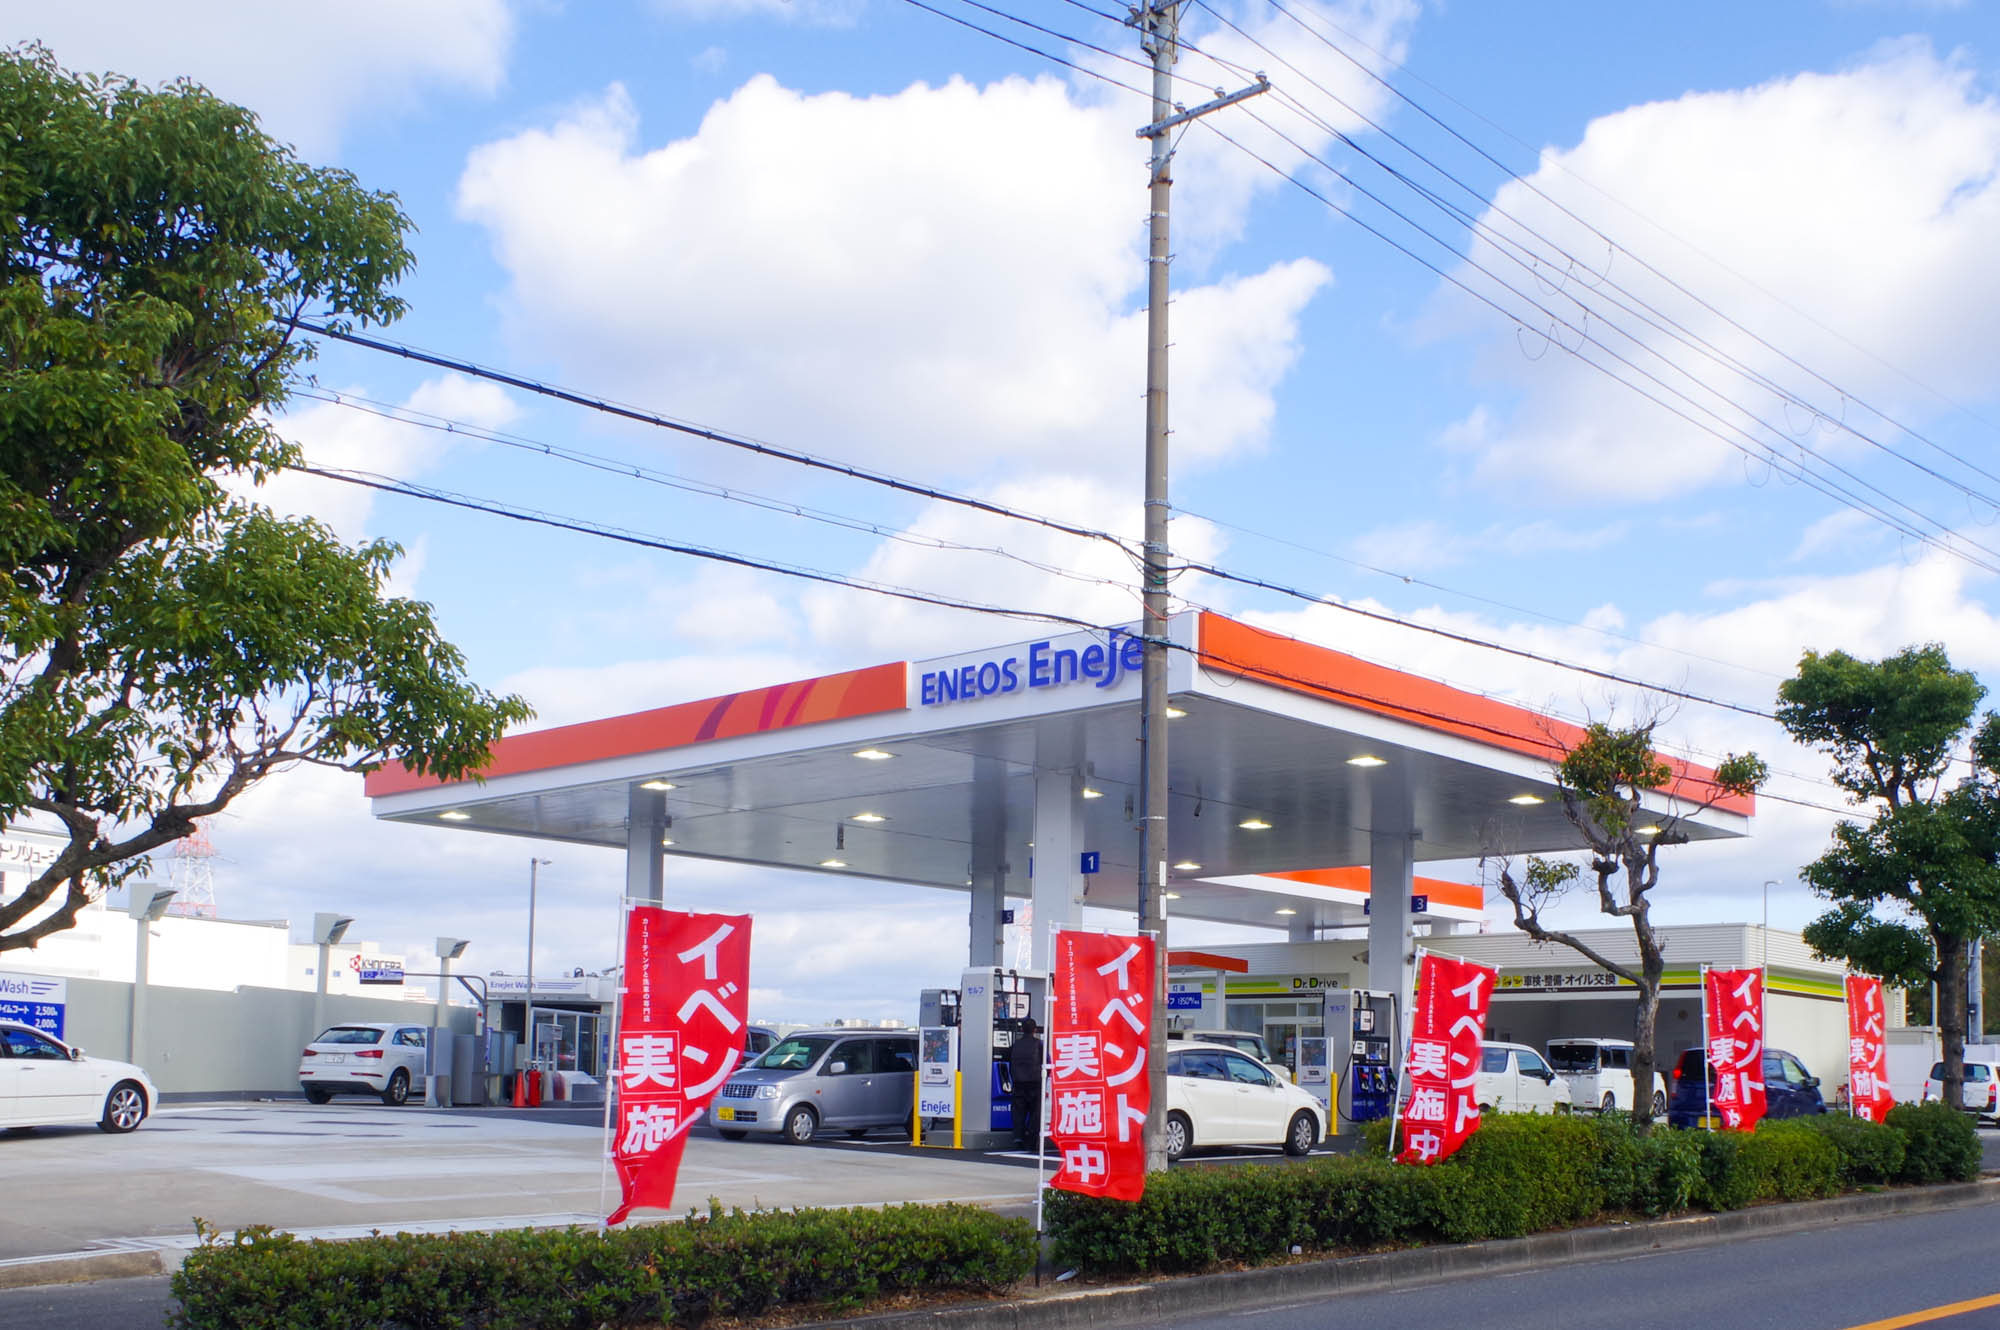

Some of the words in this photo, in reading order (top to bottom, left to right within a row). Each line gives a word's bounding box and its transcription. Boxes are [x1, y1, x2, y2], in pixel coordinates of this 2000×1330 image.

[921, 657, 1018, 705] ENEOS
[1029, 626, 1143, 688] Eneje
[1087, 855, 1095, 870] 1
[1416, 897, 1424, 910] 3
[677, 922, 741, 1101] イベン
[1096, 943, 1147, 1143] イベント
[1449, 972, 1487, 1134] イベント
[1732, 973, 1765, 1105] イベント
[1864, 983, 1890, 1101] イベント
[621, 1034, 676, 1155] 実施
[1054, 1034, 1106, 1184] 実施中
[1408, 1042, 1448, 1161] 実施中
